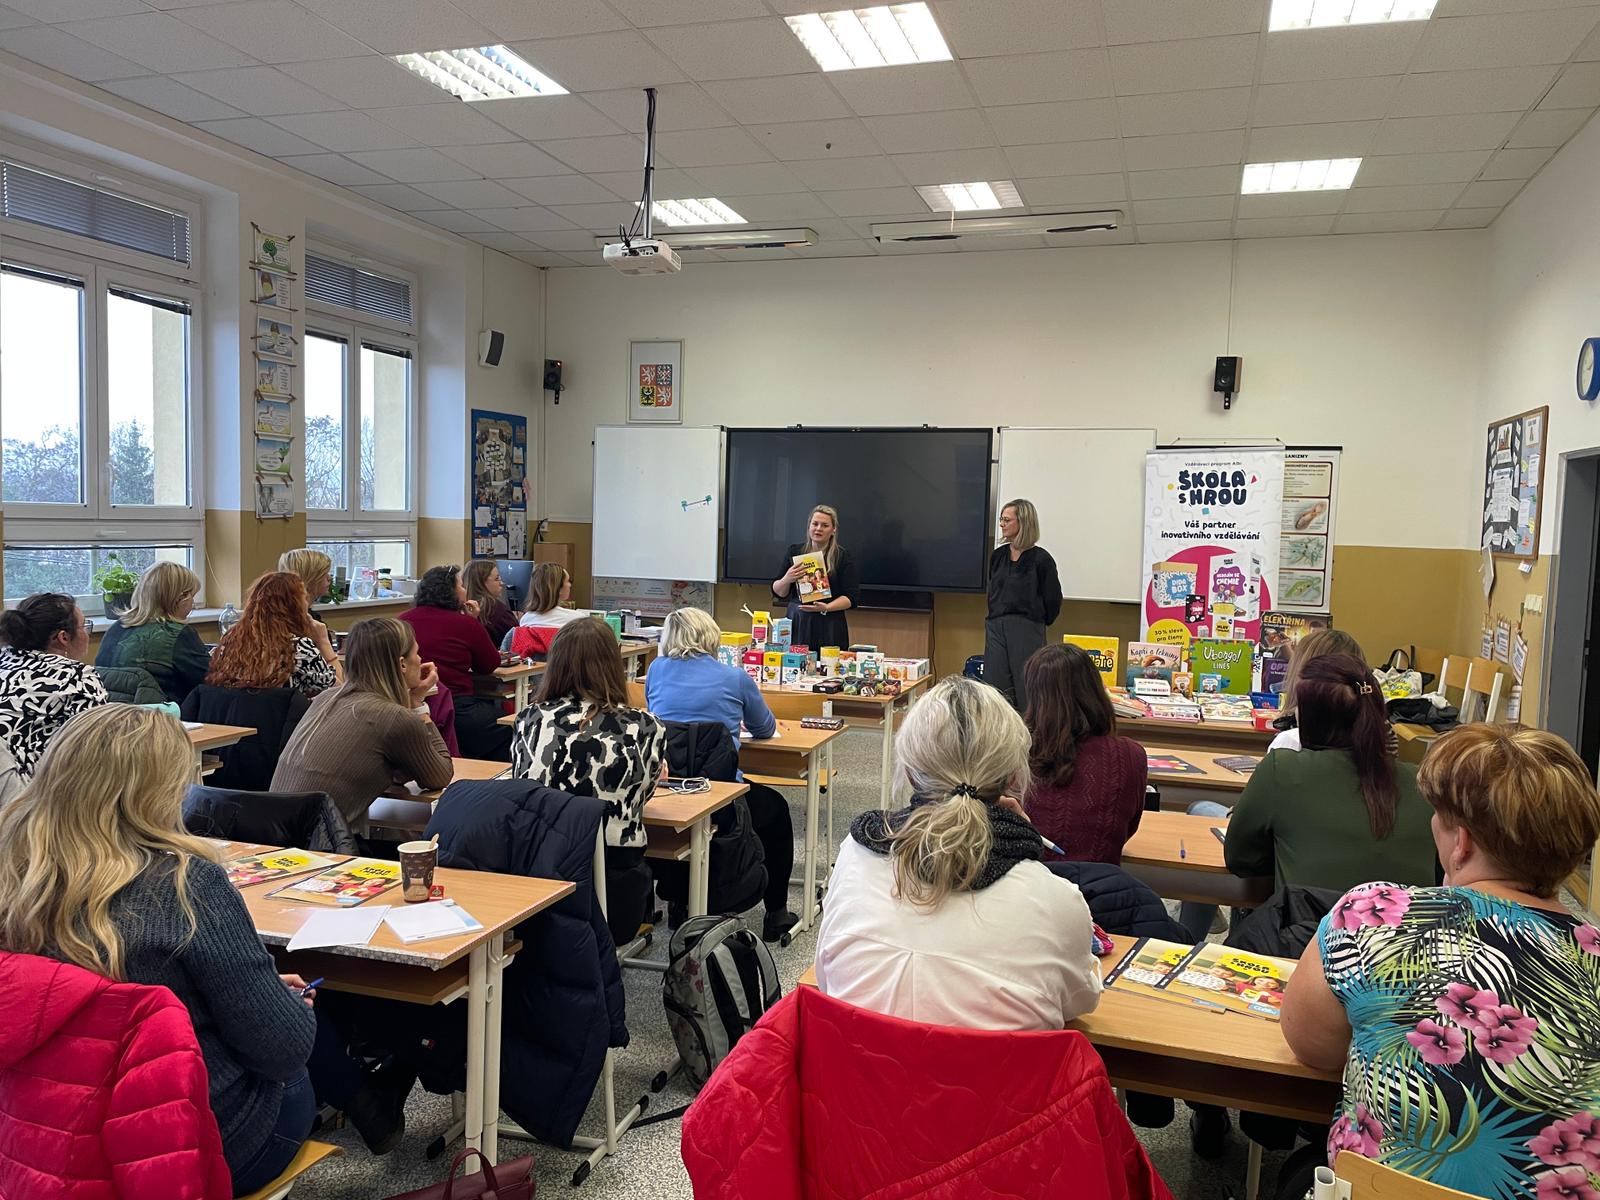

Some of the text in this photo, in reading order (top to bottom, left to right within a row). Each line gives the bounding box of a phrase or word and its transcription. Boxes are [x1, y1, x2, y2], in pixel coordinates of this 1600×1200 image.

[1178, 469, 1246, 491] ŠKOLA
[1189, 488, 1247, 506] HROU
[1184, 519, 1237, 530] Váš partner
[1161, 530, 1261, 540] inovativního vzdělávání
[1171, 585, 1188, 593] BOX
[1263, 614, 1306, 626] ELEKTŘINA
[1203, 645, 1242, 663] Ubongo!
[1212, 662, 1231, 670] LINES
[1270, 662, 1288, 671] OPT
